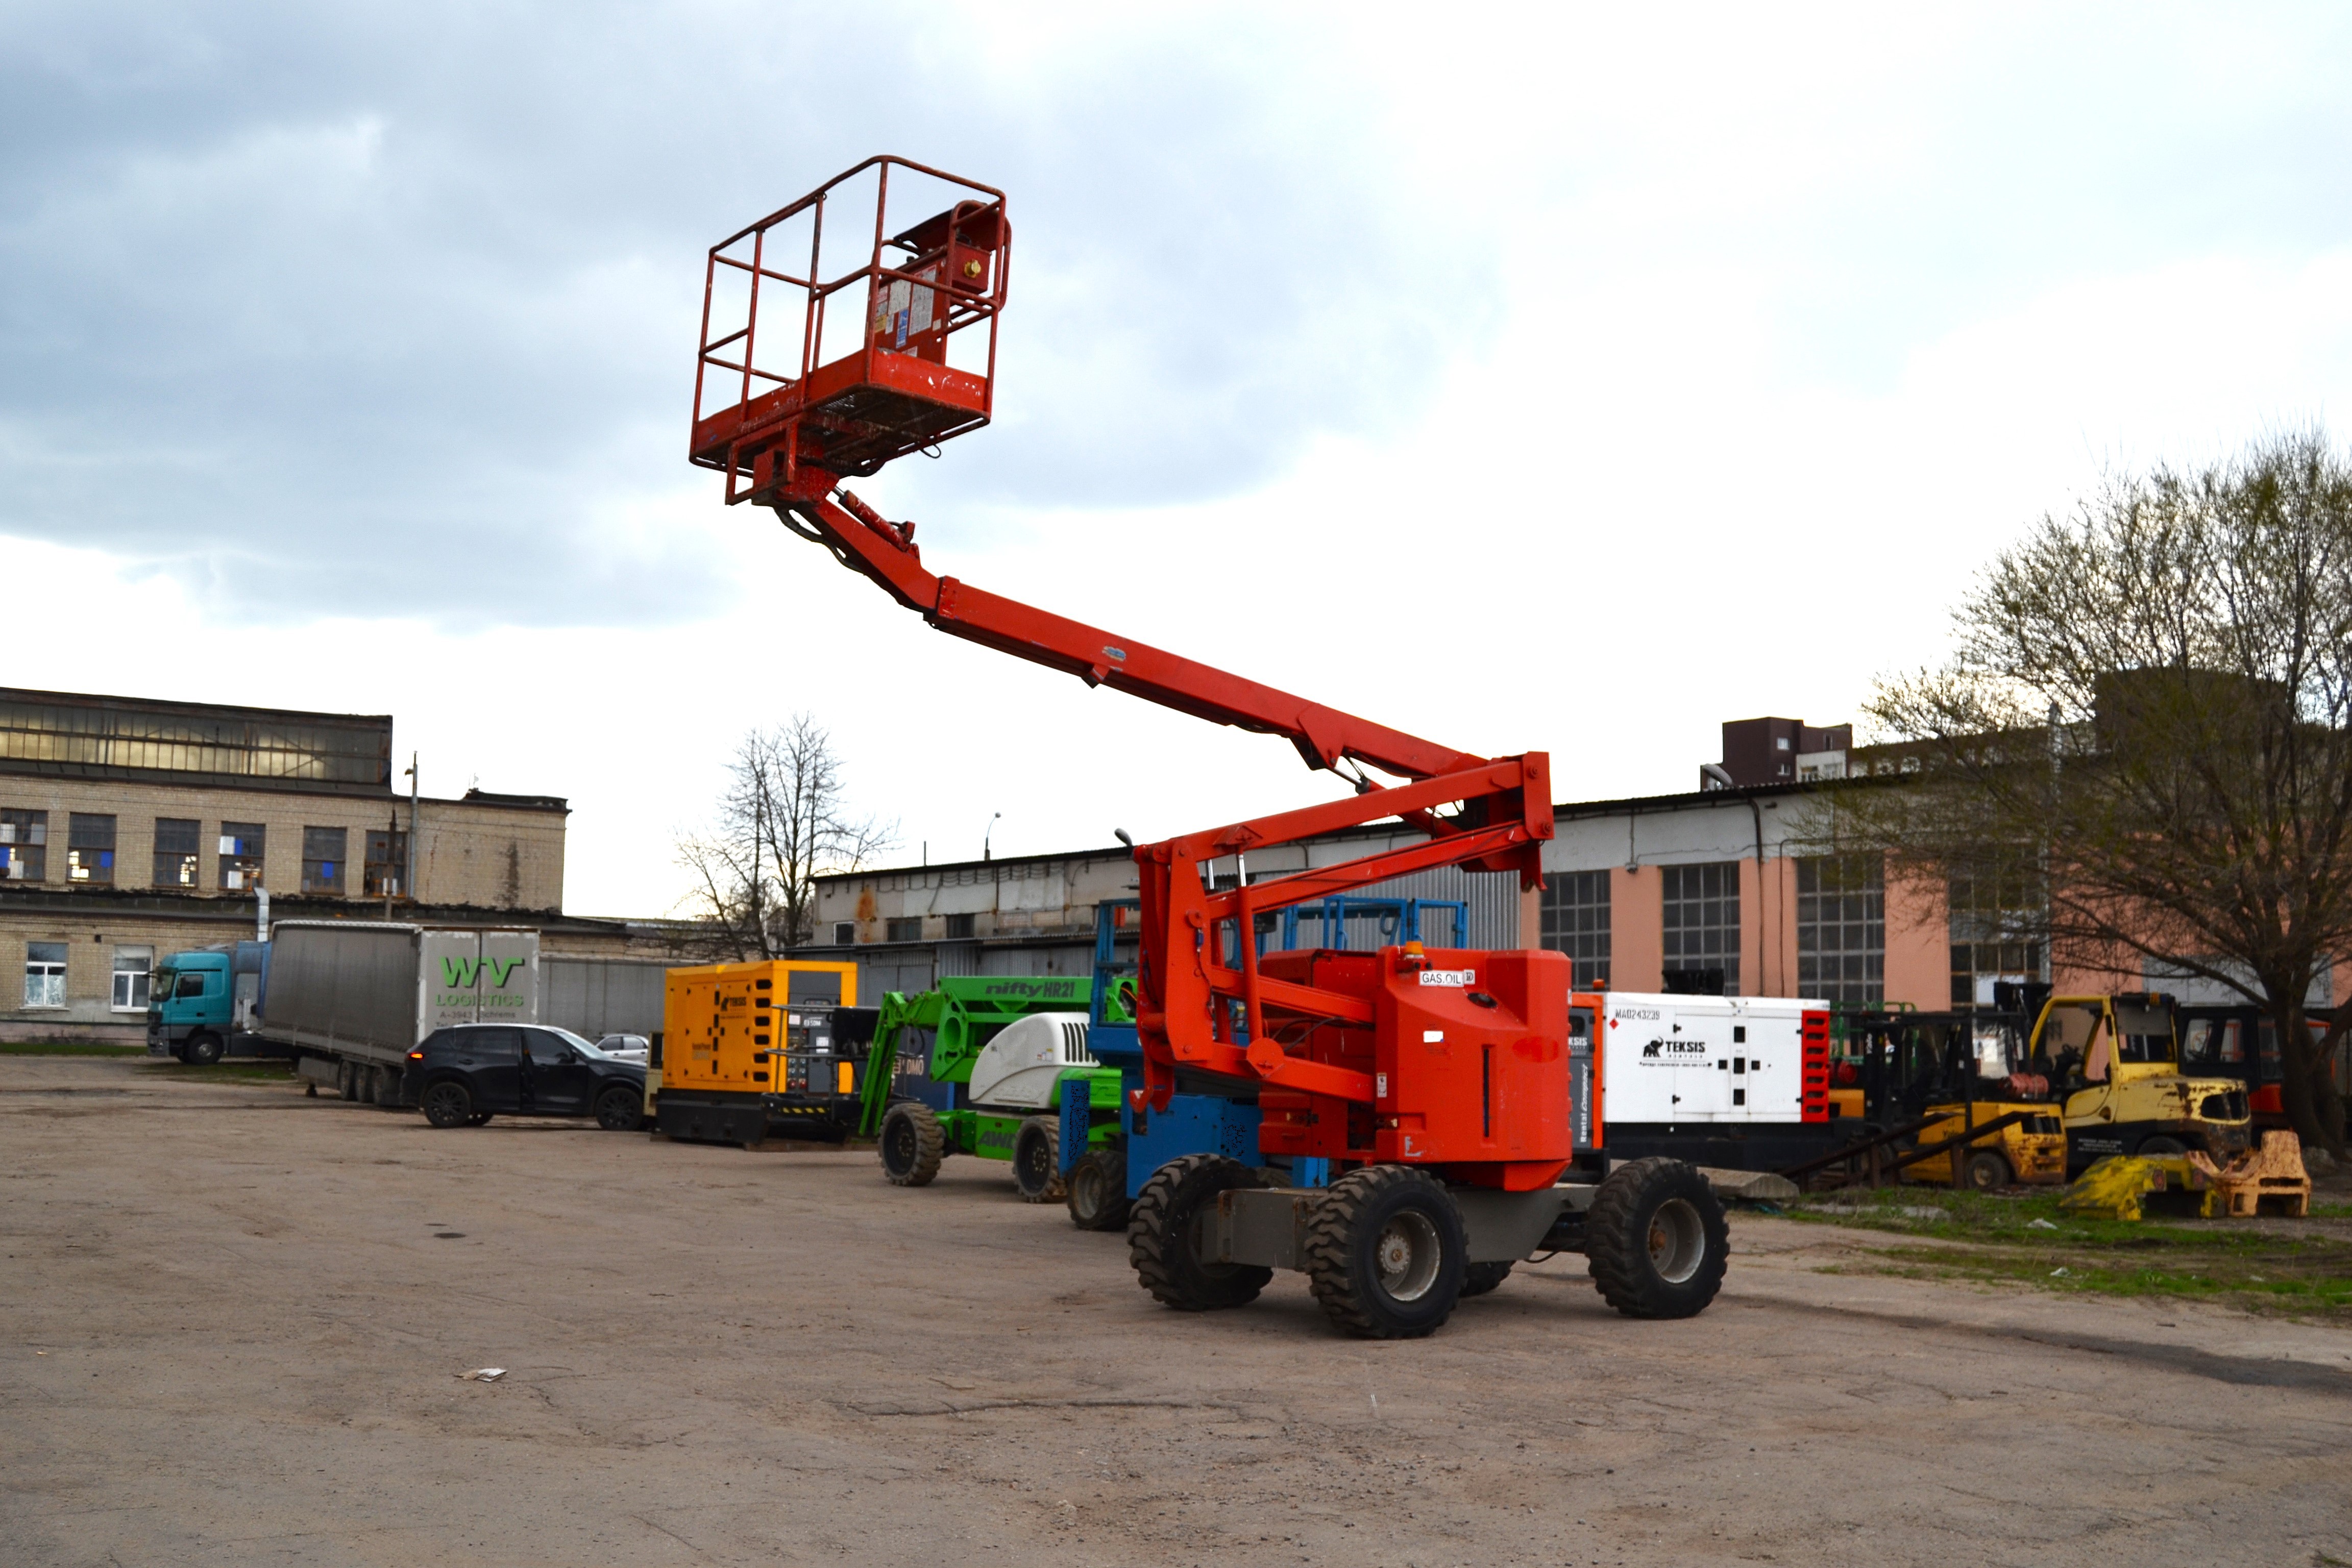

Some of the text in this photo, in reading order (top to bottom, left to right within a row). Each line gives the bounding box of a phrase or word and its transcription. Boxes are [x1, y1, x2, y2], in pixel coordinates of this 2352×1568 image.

[439, 956, 525, 988] WV
[1422, 973, 1461, 984] GAS.OIL
[984, 981, 1075, 997] nifty HR21
[436, 994, 523, 1007] LOGISTICS
[1569, 1037, 1587, 1046] KSIS
[1665, 1041, 1706, 1053] TEKSIS
[902, 1058, 924, 1075] DMO
